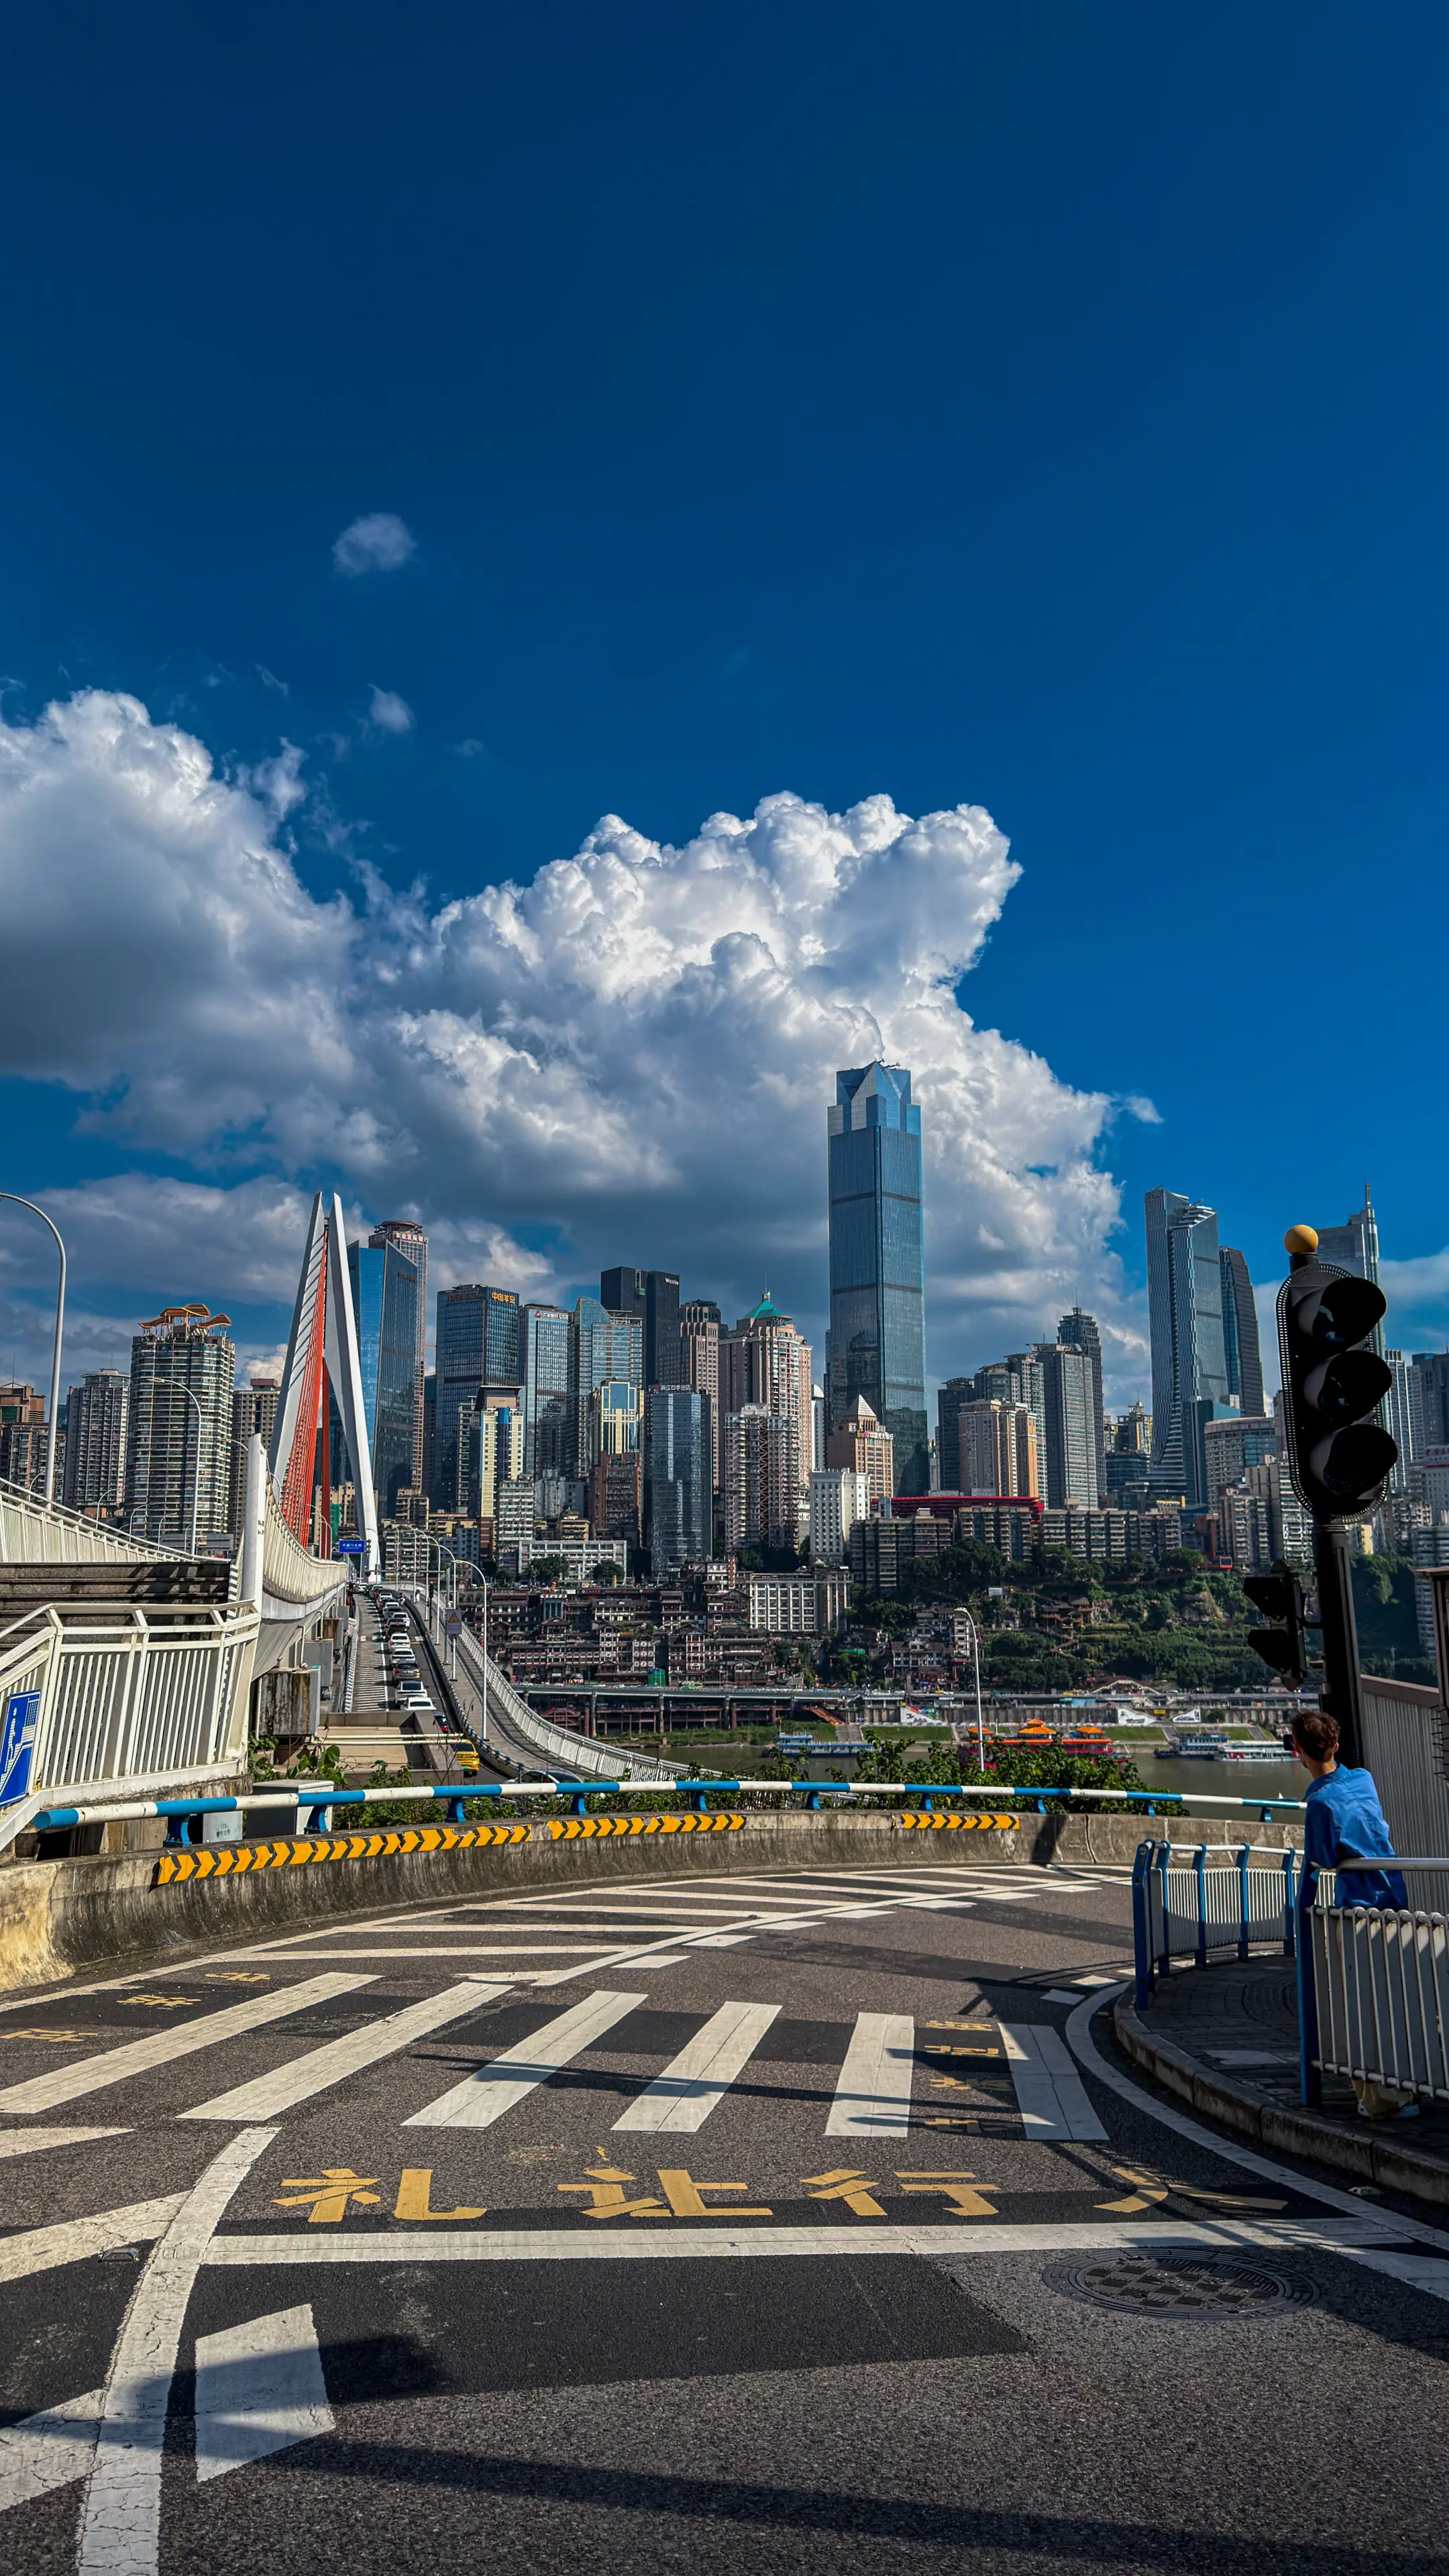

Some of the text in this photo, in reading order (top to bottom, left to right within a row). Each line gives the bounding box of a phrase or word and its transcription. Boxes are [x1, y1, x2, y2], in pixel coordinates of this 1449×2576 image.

[491, 1292, 515, 1304] 中国平安
[270, 2167, 1288, 2222] 礼让行人
